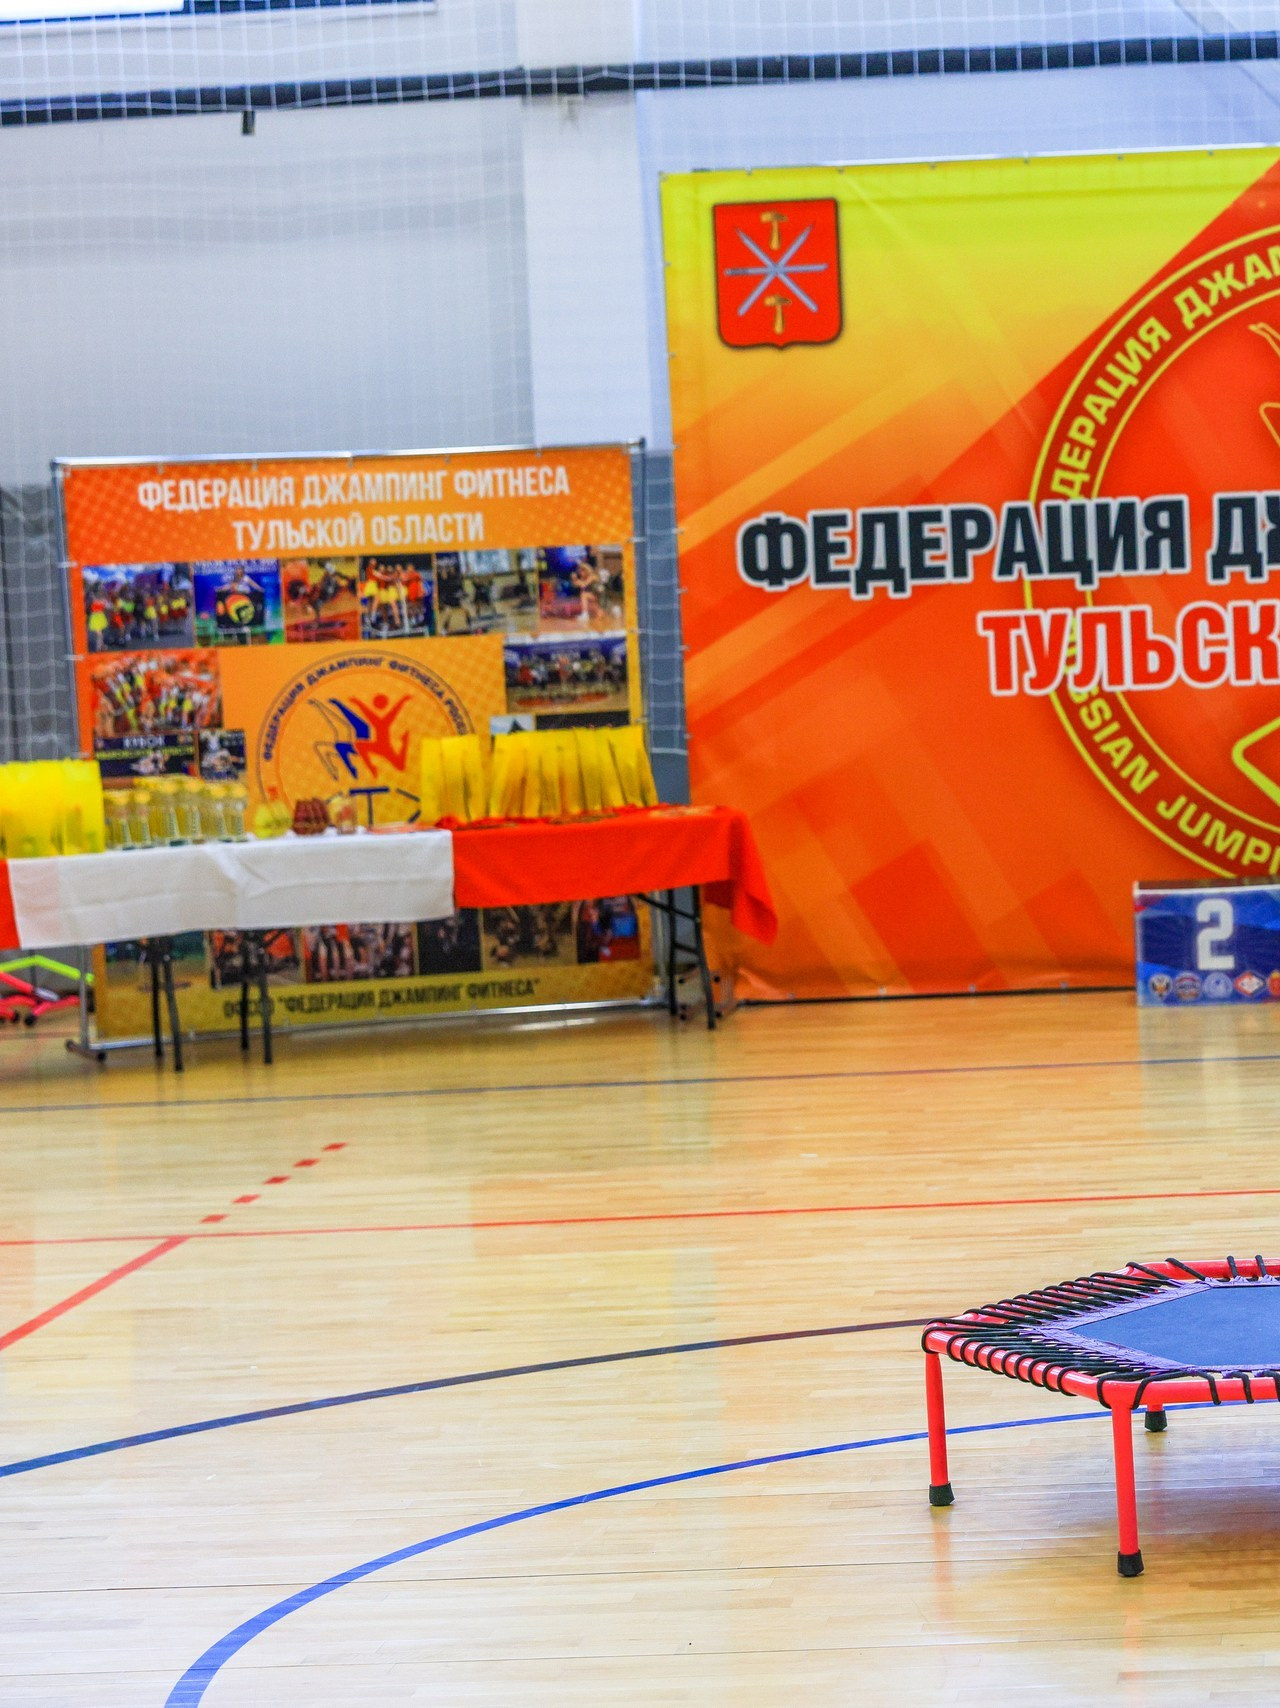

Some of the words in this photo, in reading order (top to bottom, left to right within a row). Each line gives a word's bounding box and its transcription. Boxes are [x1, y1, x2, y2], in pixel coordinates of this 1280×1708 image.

[1051, 316, 1171, 500] ДЕРАЦИЯ
[138, 476, 295, 513] ФЕДЕРАЦИЯ
[301, 470, 448, 508] ДЖАМПИНГ
[454, 465, 570, 499] ФИТНЕСА
[232, 511, 364, 551] ТУЛЬСКОЙ
[371, 512, 485, 547] ОБЛАСТИ
[738, 495, 1190, 600] ФЕДЕРАЦИЯ
[1196, 898, 1236, 970] 2
